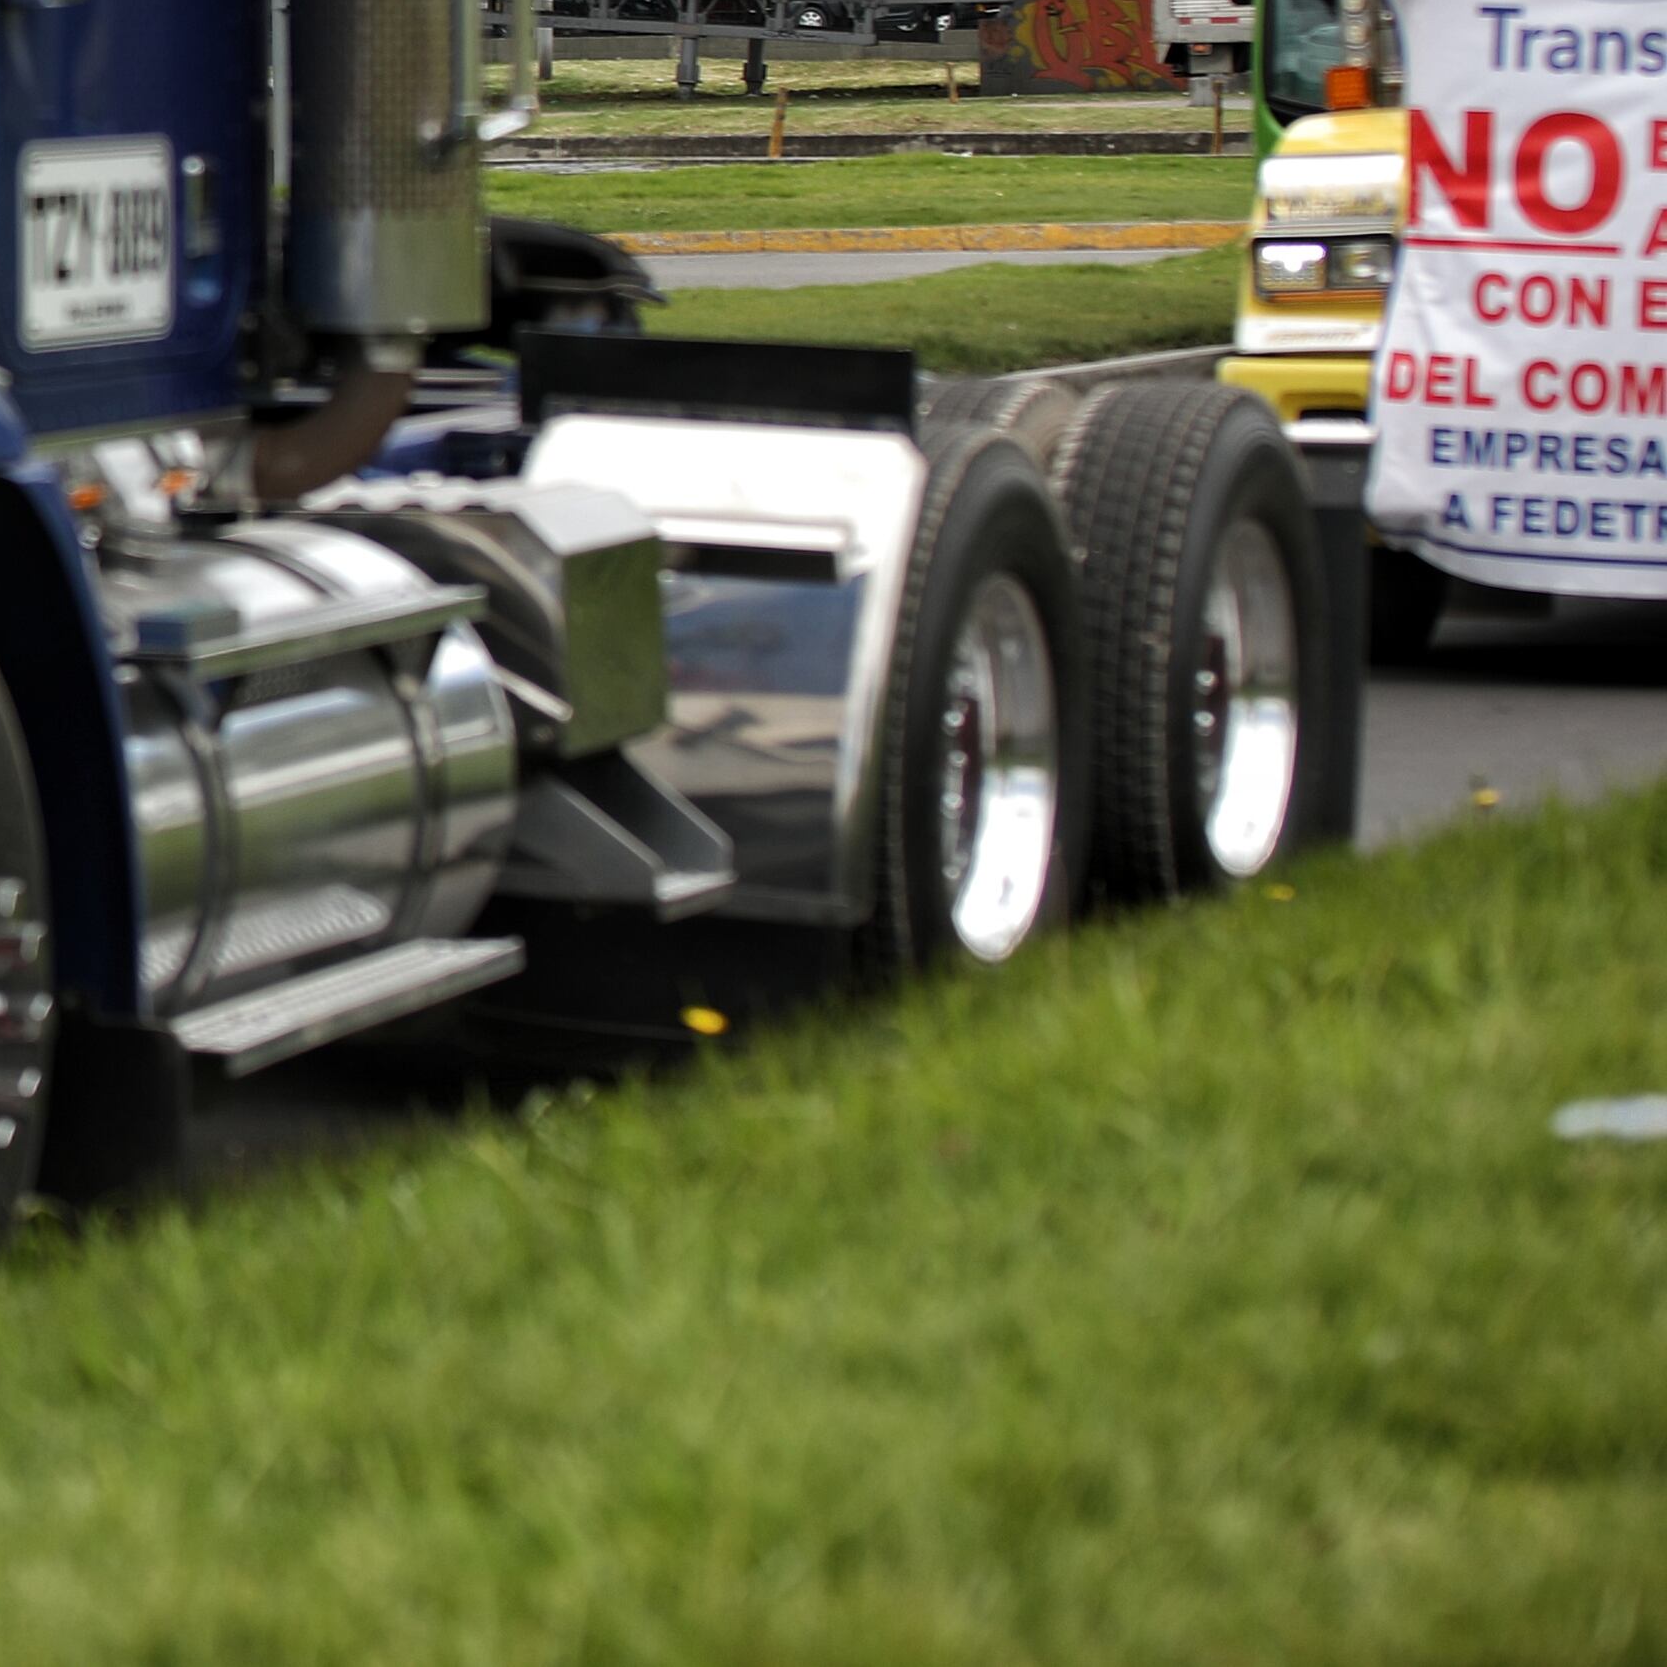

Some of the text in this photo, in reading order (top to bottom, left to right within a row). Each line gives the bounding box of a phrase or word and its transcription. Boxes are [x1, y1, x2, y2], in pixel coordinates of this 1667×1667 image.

[1480, 4, 1667, 75] Trans
[1407, 108, 1624, 234] NO
[1472, 272, 1609, 327] CON
[1384, 350, 1667, 415] DEL COM
[1430, 427, 1667, 478] EMPRESA
[1442, 493, 1475, 533] A
